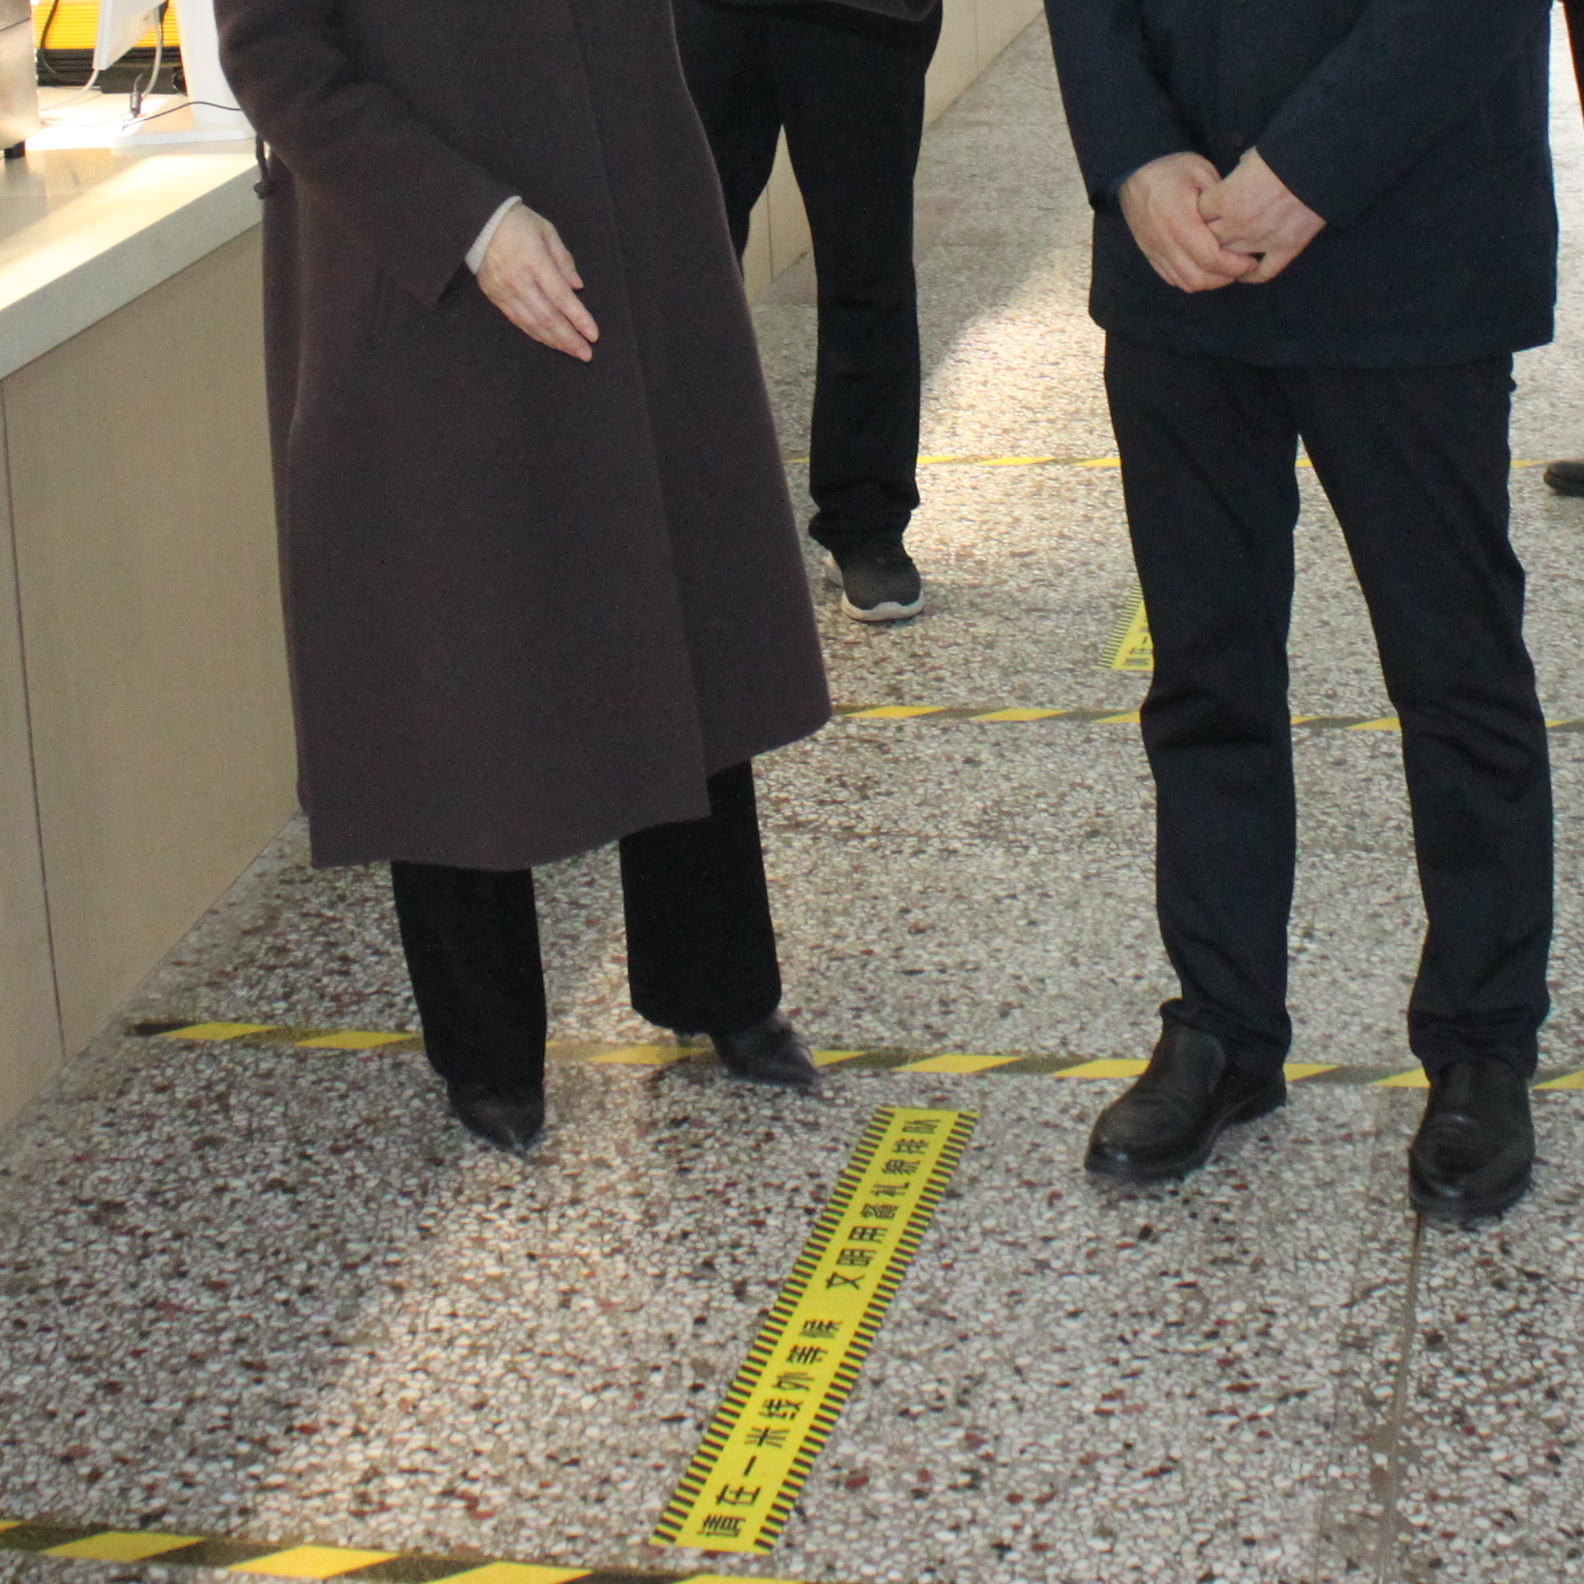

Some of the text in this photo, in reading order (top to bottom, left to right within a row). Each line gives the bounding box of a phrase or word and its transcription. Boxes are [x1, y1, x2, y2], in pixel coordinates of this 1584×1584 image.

[699, 1118, 941, 1535] 请在一米线外等候 文明用餐礼貌排队
